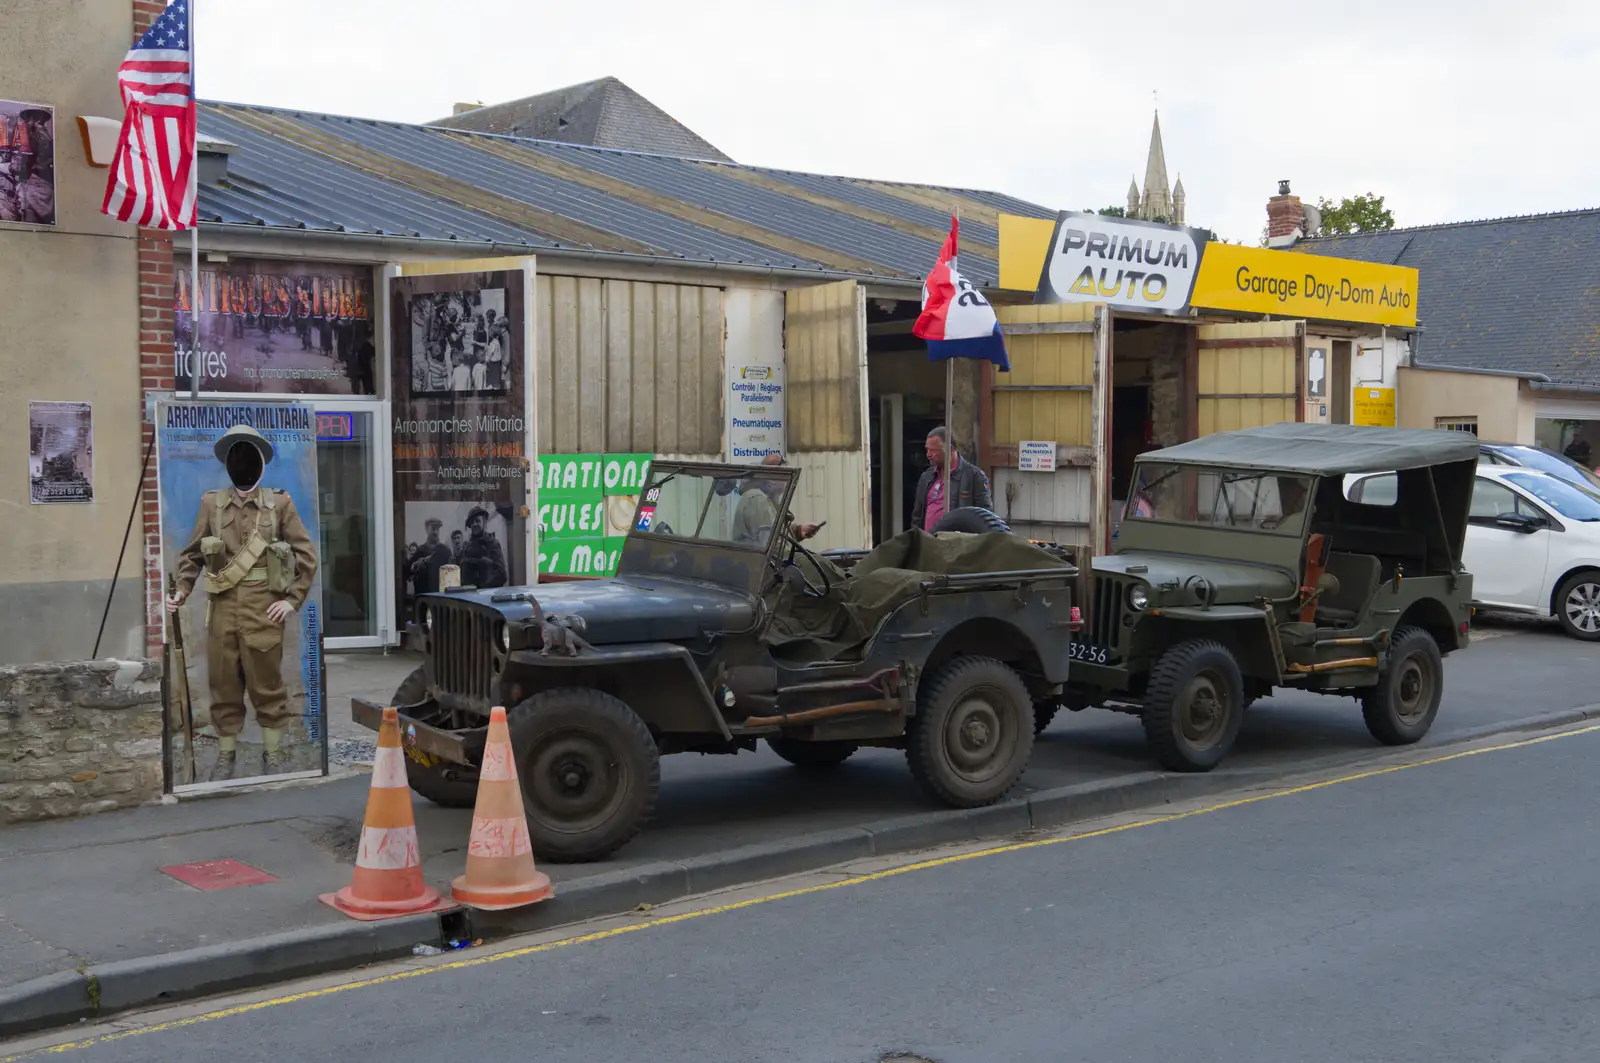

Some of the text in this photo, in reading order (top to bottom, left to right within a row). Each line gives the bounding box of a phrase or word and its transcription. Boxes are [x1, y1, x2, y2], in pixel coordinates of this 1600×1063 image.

[1062, 229, 1188, 269] PRIMUM
[1068, 266, 1167, 302] AUTO
[1236, 266, 1411, 308] Garage Day-Dom Auto
[296, 275, 367, 321] STORE
[732, 382, 755, 392] Contrôle
[760, 383, 782, 394] Réglage
[166, 406, 310, 430] ARROMANCHES MILITARIA
[394, 414, 523, 433] Arromanches Militaria
[732, 418, 782, 430] Pneumatiques
[733, 448, 780, 457] Distribution
[437, 464, 522, 480] Antiquités Militaires
[647, 489, 659, 500] 80
[638, 512, 653, 526] 75
[570, 545, 621, 573] Mar
[1069, 642, 1106, 663] 32-56
